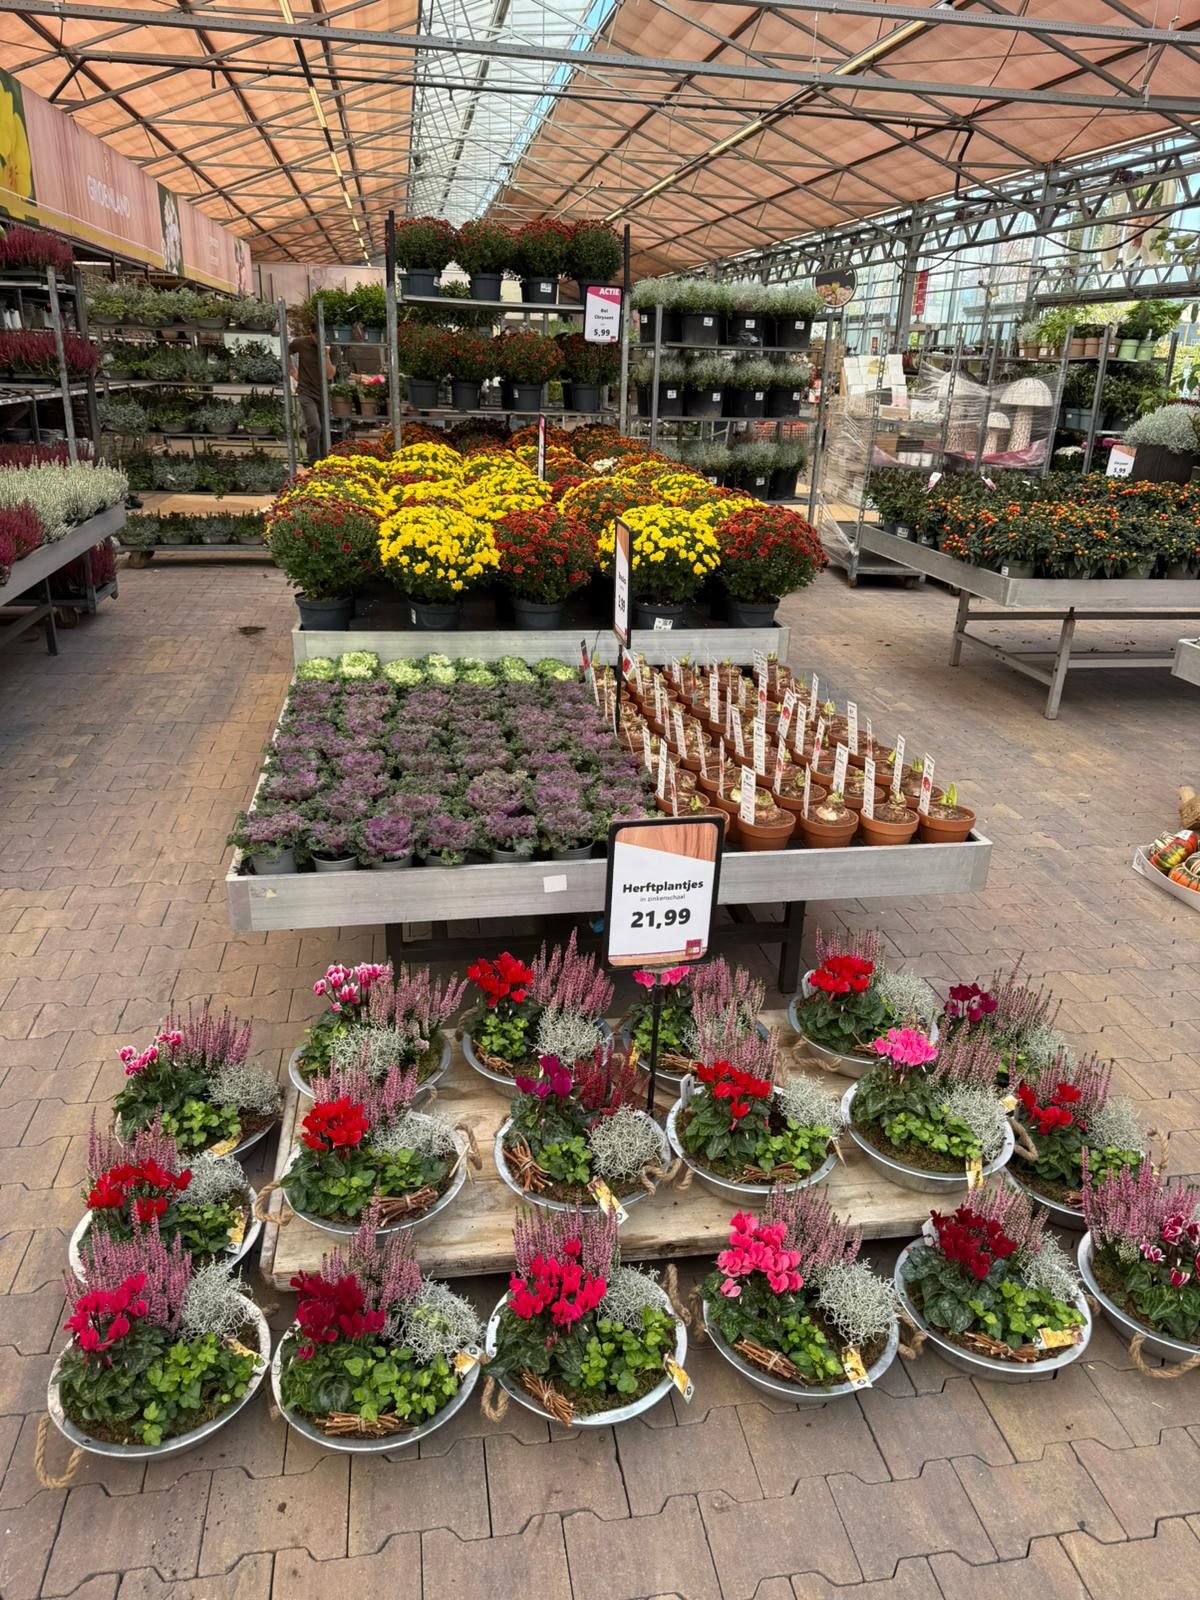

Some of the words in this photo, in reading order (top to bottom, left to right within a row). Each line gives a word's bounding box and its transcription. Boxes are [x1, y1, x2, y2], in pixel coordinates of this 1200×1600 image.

[599, 287, 620, 296] ACTIE
[594, 328, 611, 337] 5,99
[622, 880, 704, 895] Herftplantjes
[630, 908, 691, 929] 21,99
